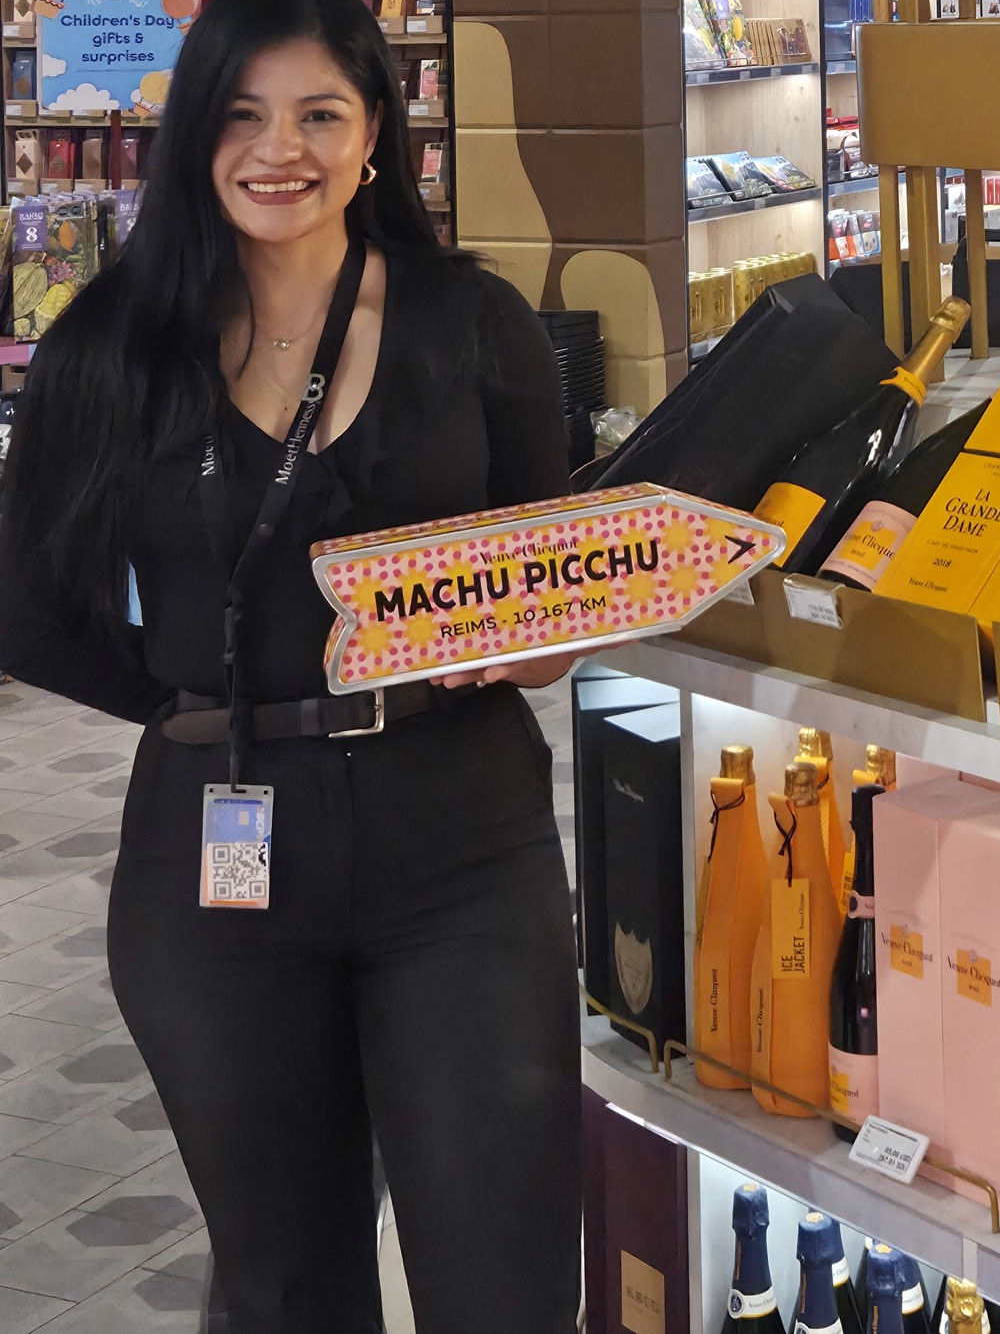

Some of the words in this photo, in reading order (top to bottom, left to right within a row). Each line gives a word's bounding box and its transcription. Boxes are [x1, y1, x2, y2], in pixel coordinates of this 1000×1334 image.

[61, 15, 141, 27] Children's
[145, 15, 175, 29] Day
[92, 32, 131, 47] gifts
[135, 33, 144, 44] &
[82, 50, 155, 65] surprises
[25, 226, 38, 242] 8
[975, 488, 991, 502] LA
[942, 515, 988, 537] DAME
[478, 549, 519, 566] Veuve
[522, 537, 579, 562] Clicquot
[932, 557, 952, 568] 2018
[374, 567, 510, 622] MACHU
[523, 540, 660, 593] PICCHU
[441, 616, 497, 638] REIMS
[513, 609, 536, 625] 10
[541, 601, 573, 619] 167
[580, 596, 607, 612] KM
[794, 937, 806, 973] JACKET
[881, 931, 903, 950] Veuve
[903, 941, 934, 963] Clicquot
[782, 955, 793, 972] ICE
[947, 956, 969, 975] Veuve
